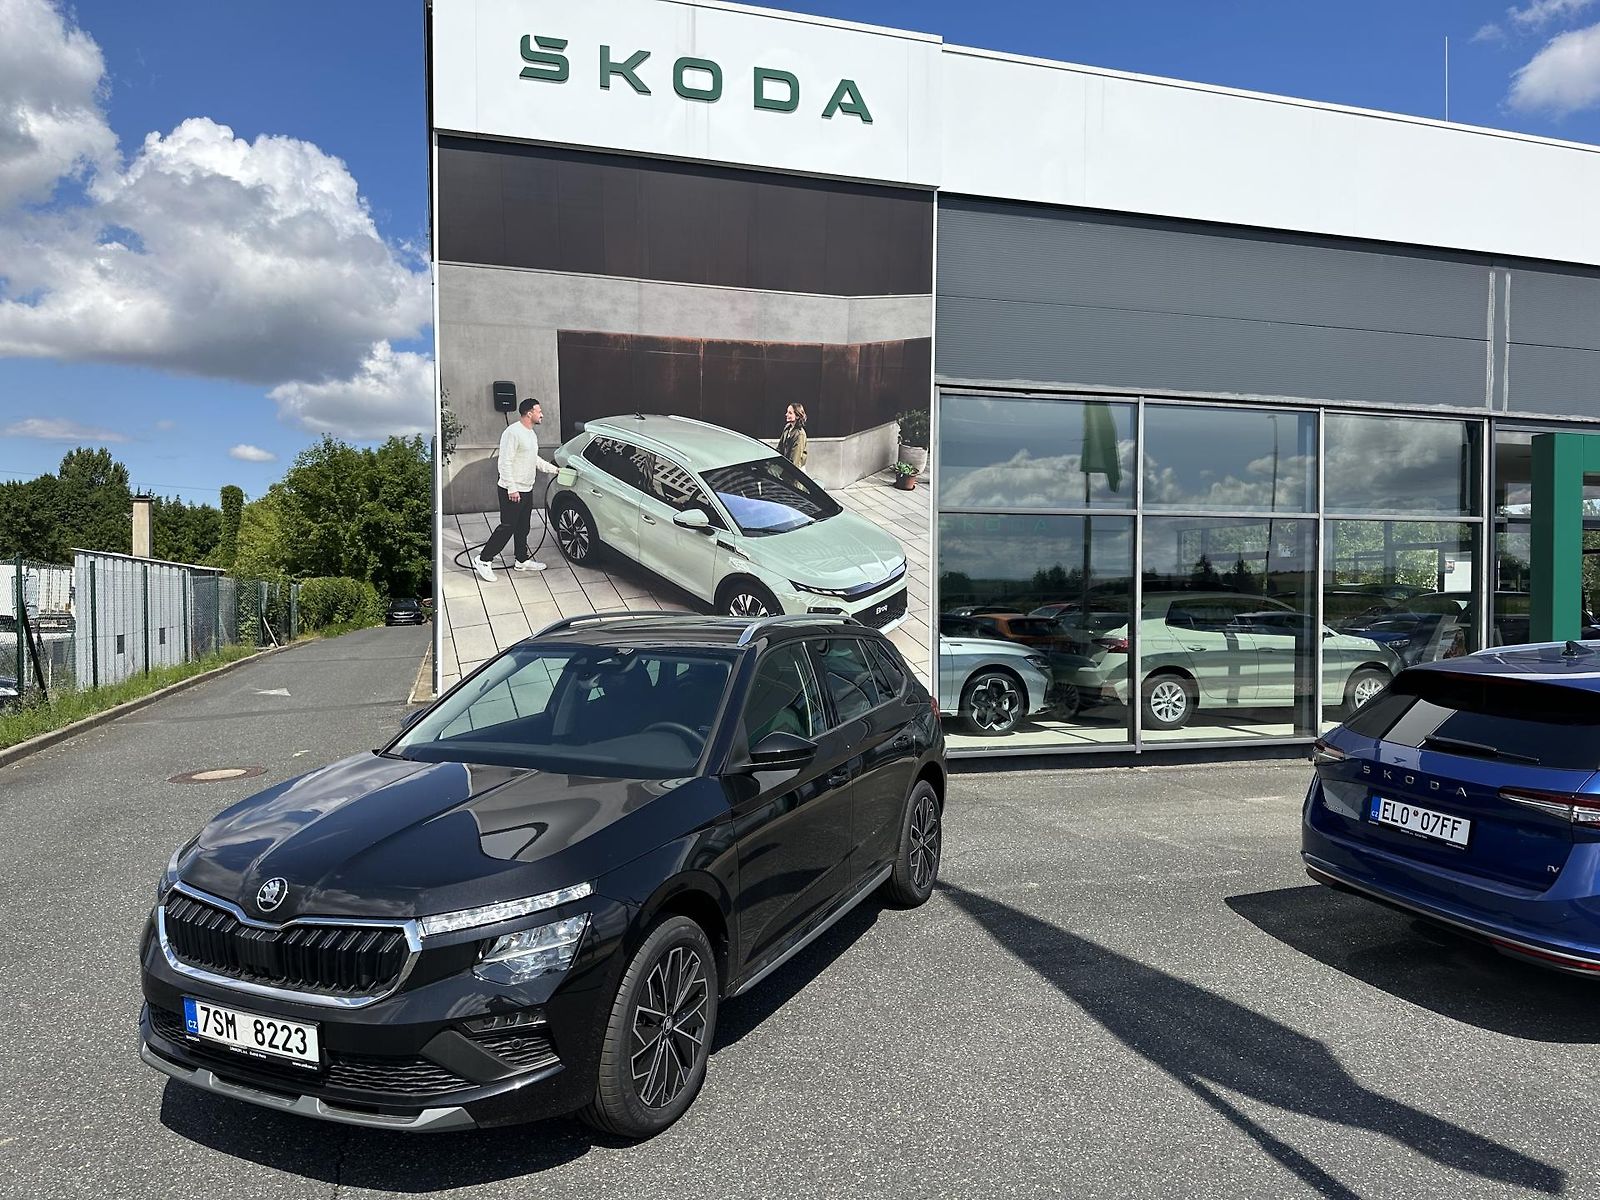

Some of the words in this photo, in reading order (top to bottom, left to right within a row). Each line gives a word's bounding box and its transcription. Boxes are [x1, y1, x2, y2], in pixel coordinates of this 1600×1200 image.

[1363, 765, 1467, 798] SKODA
[1371, 810, 1379, 818] CZ
[188, 1019, 198, 1029] CZ
[200, 1005, 238, 1041] 7SM
[253, 1019, 307, 1055] 8223
